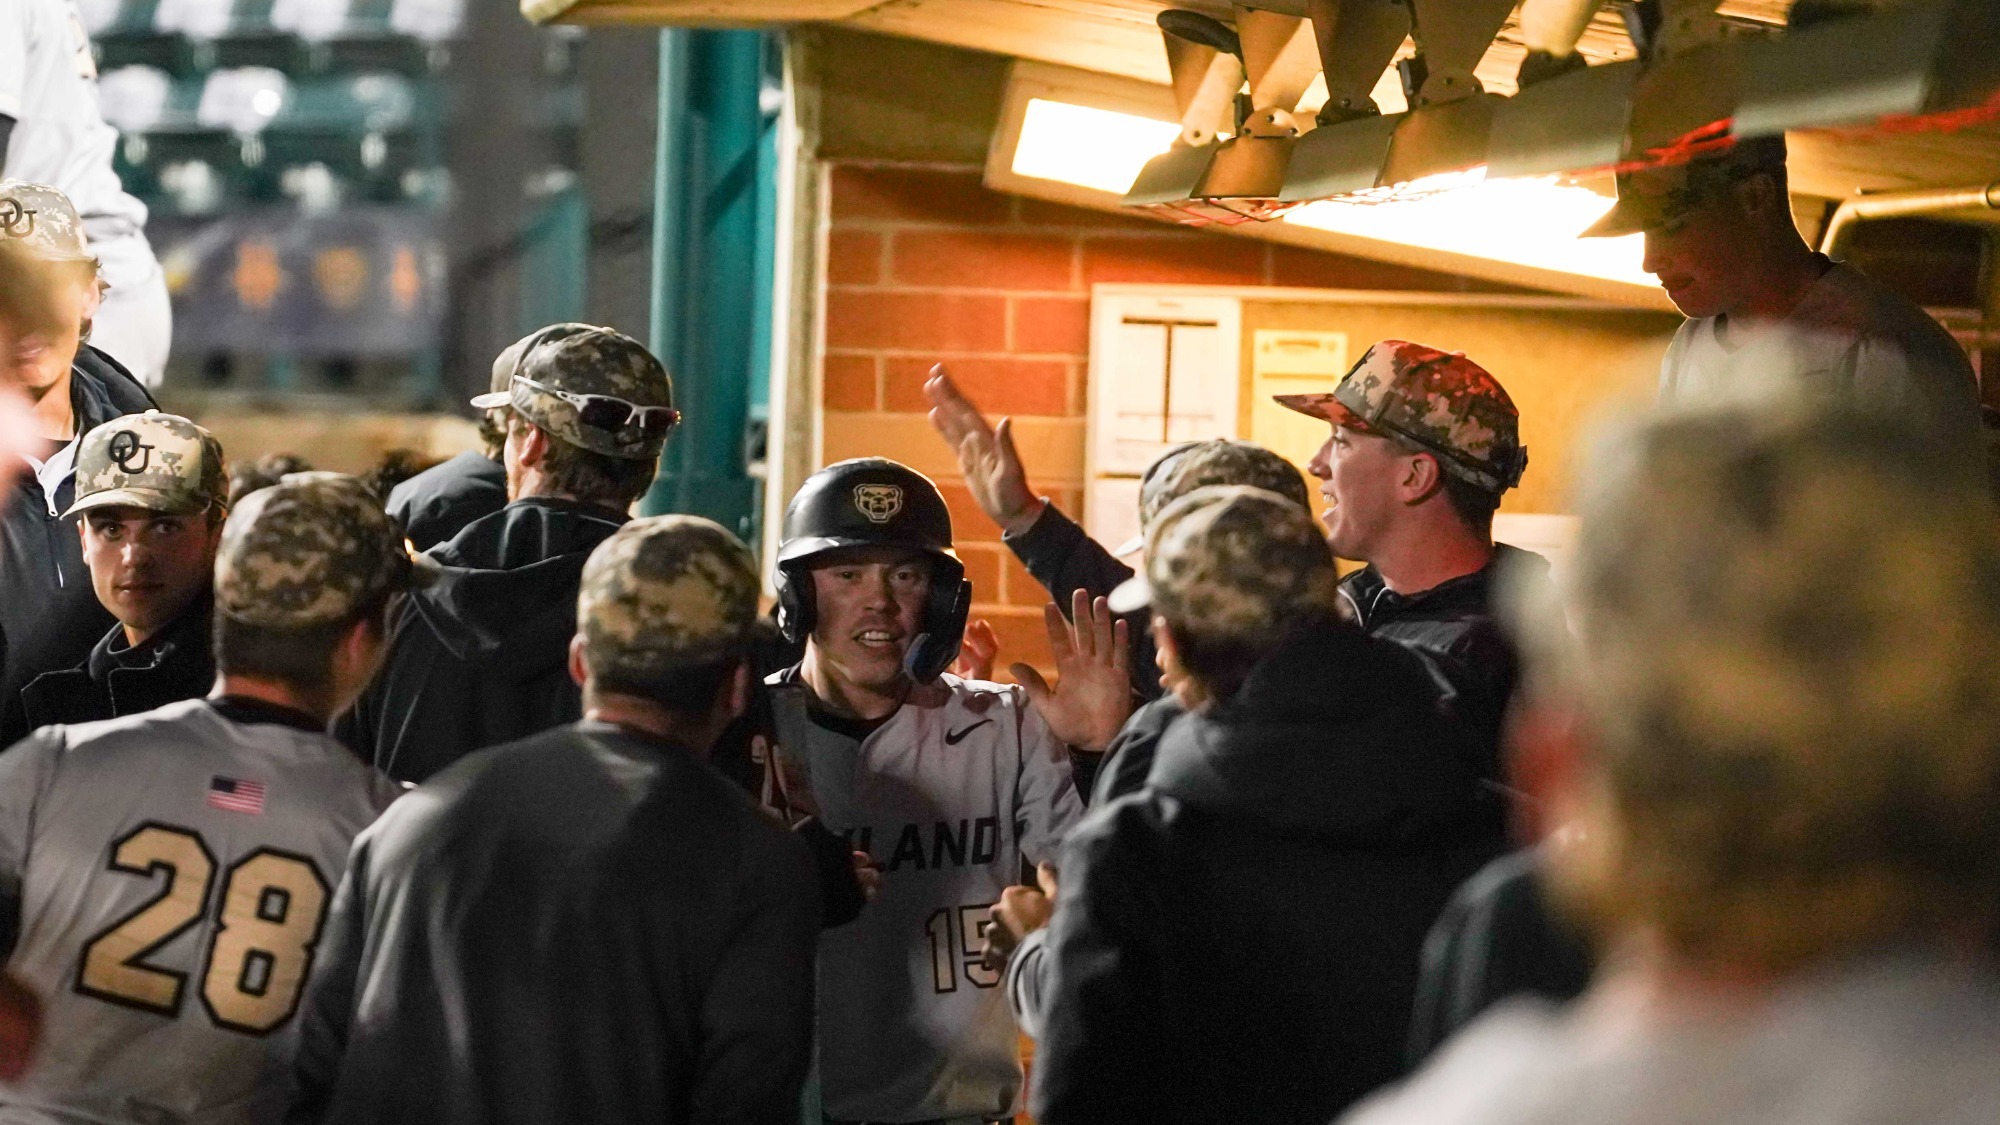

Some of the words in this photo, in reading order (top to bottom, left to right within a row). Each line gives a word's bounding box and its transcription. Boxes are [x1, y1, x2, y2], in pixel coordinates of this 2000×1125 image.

[108, 430, 155, 474] OU
[846, 816, 999, 872] LAND
[73, 819, 333, 1038] 28
[925, 902, 1001, 995] 15
